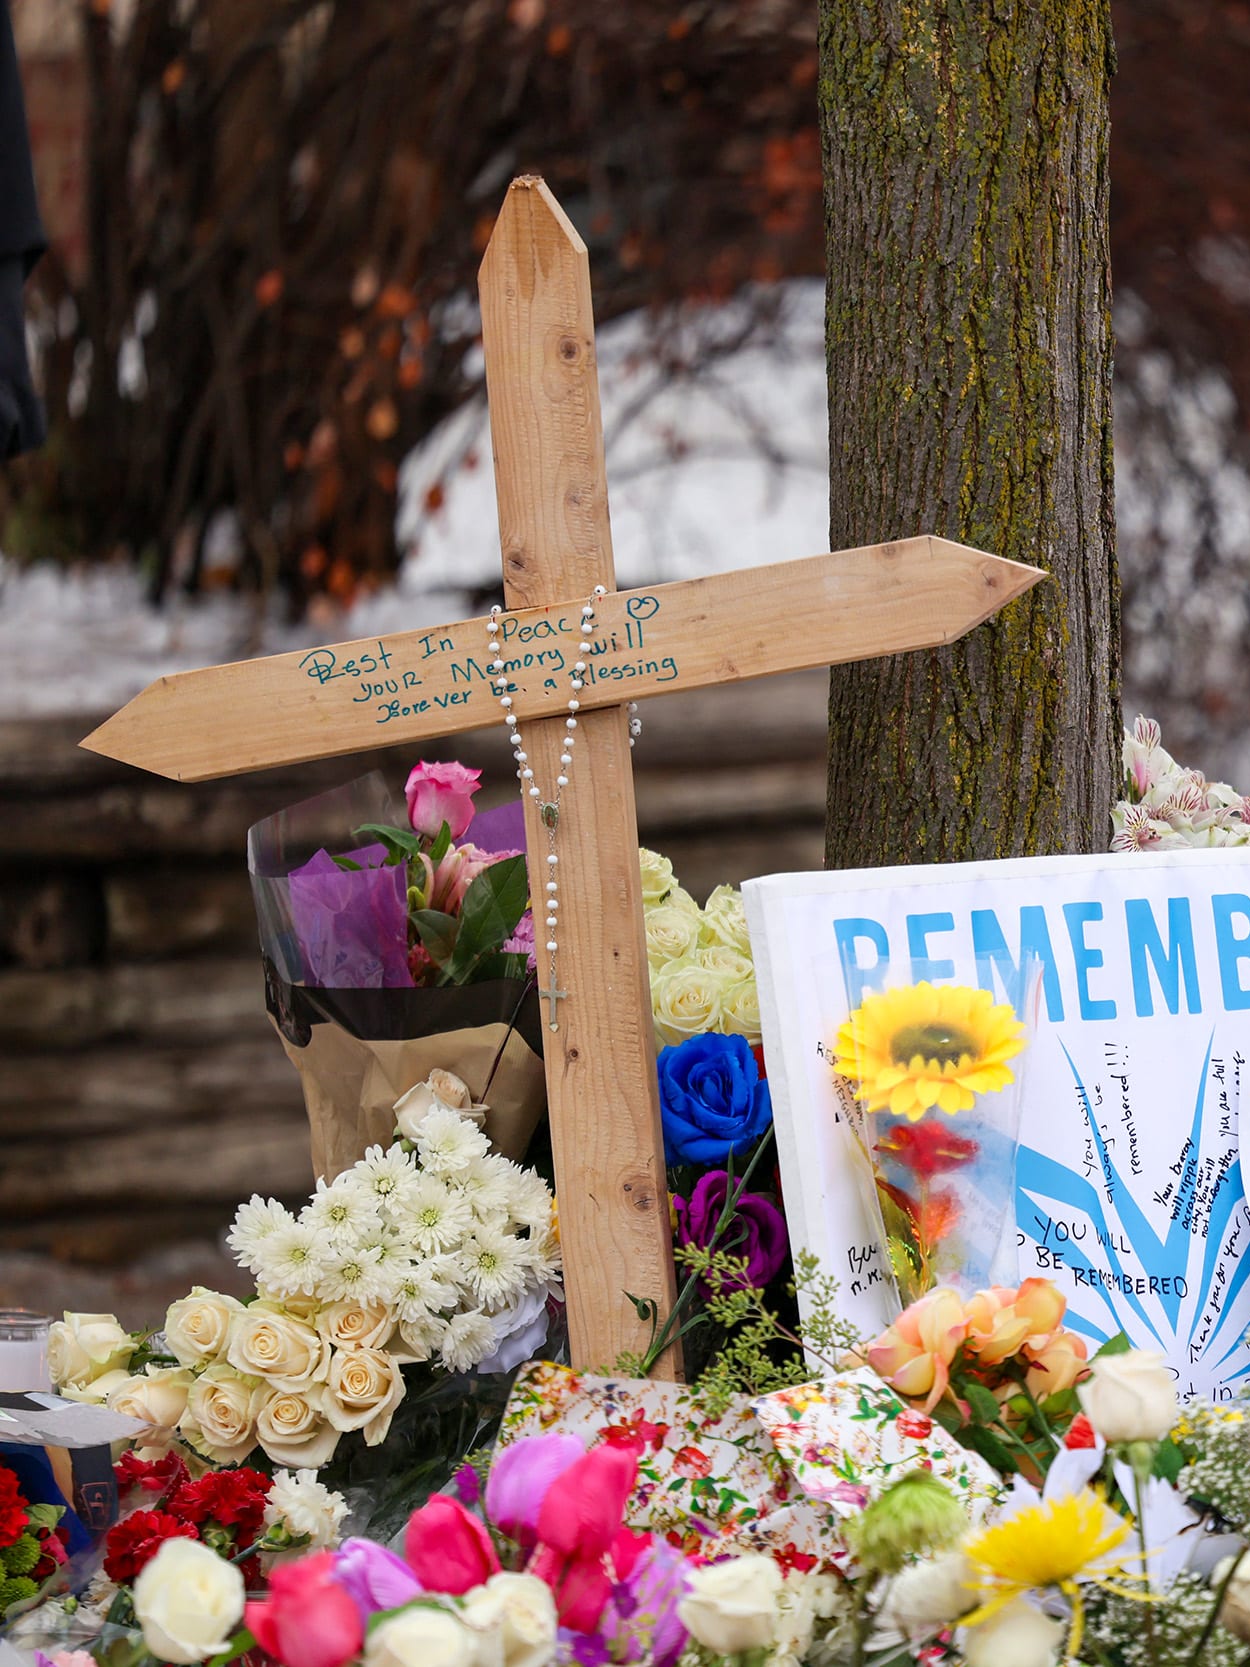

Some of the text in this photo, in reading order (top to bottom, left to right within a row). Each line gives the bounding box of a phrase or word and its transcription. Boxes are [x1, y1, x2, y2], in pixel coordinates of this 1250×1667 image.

[299, 641, 392, 684] Rest
[418, 634, 455, 659] In
[451, 649, 565, 683] Memory
[589, 620, 643, 655] will
[490, 681, 518, 696] be
[544, 678, 557, 688] a
[1095, 1084, 1104, 1106] be
[1074, 1086, 1098, 1178] You will
[1206, 1157, 1216, 1181] will
[1170, 1195, 1184, 1221] will
[1181, 1167, 1204, 1231] across our
[1034, 1216, 1087, 1245] YOU
[1096, 1226, 1131, 1254] WILL
[1201, 1219, 1210, 1238] not
[1035, 1246, 1065, 1269] BE
[1073, 1266, 1188, 1299] REMEMBERED
